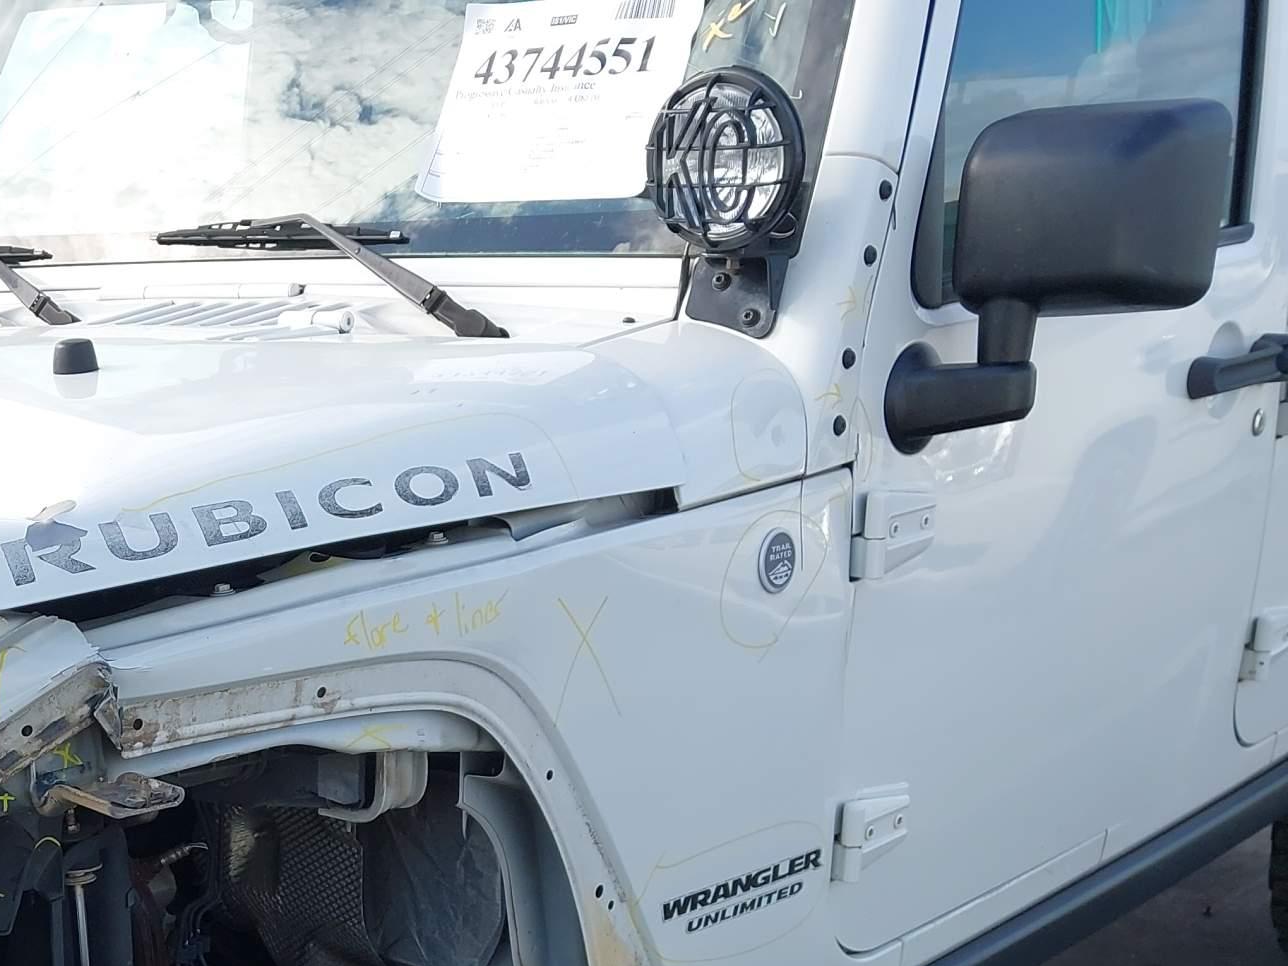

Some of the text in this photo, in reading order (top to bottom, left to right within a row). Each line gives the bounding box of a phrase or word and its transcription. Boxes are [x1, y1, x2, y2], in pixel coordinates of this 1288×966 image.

[474, 35, 657, 86] 43744551
[0, 452, 533, 587] RUBICON
[661, 848, 823, 922] WRANGLER
[686, 881, 805, 933] UNLIMITED
